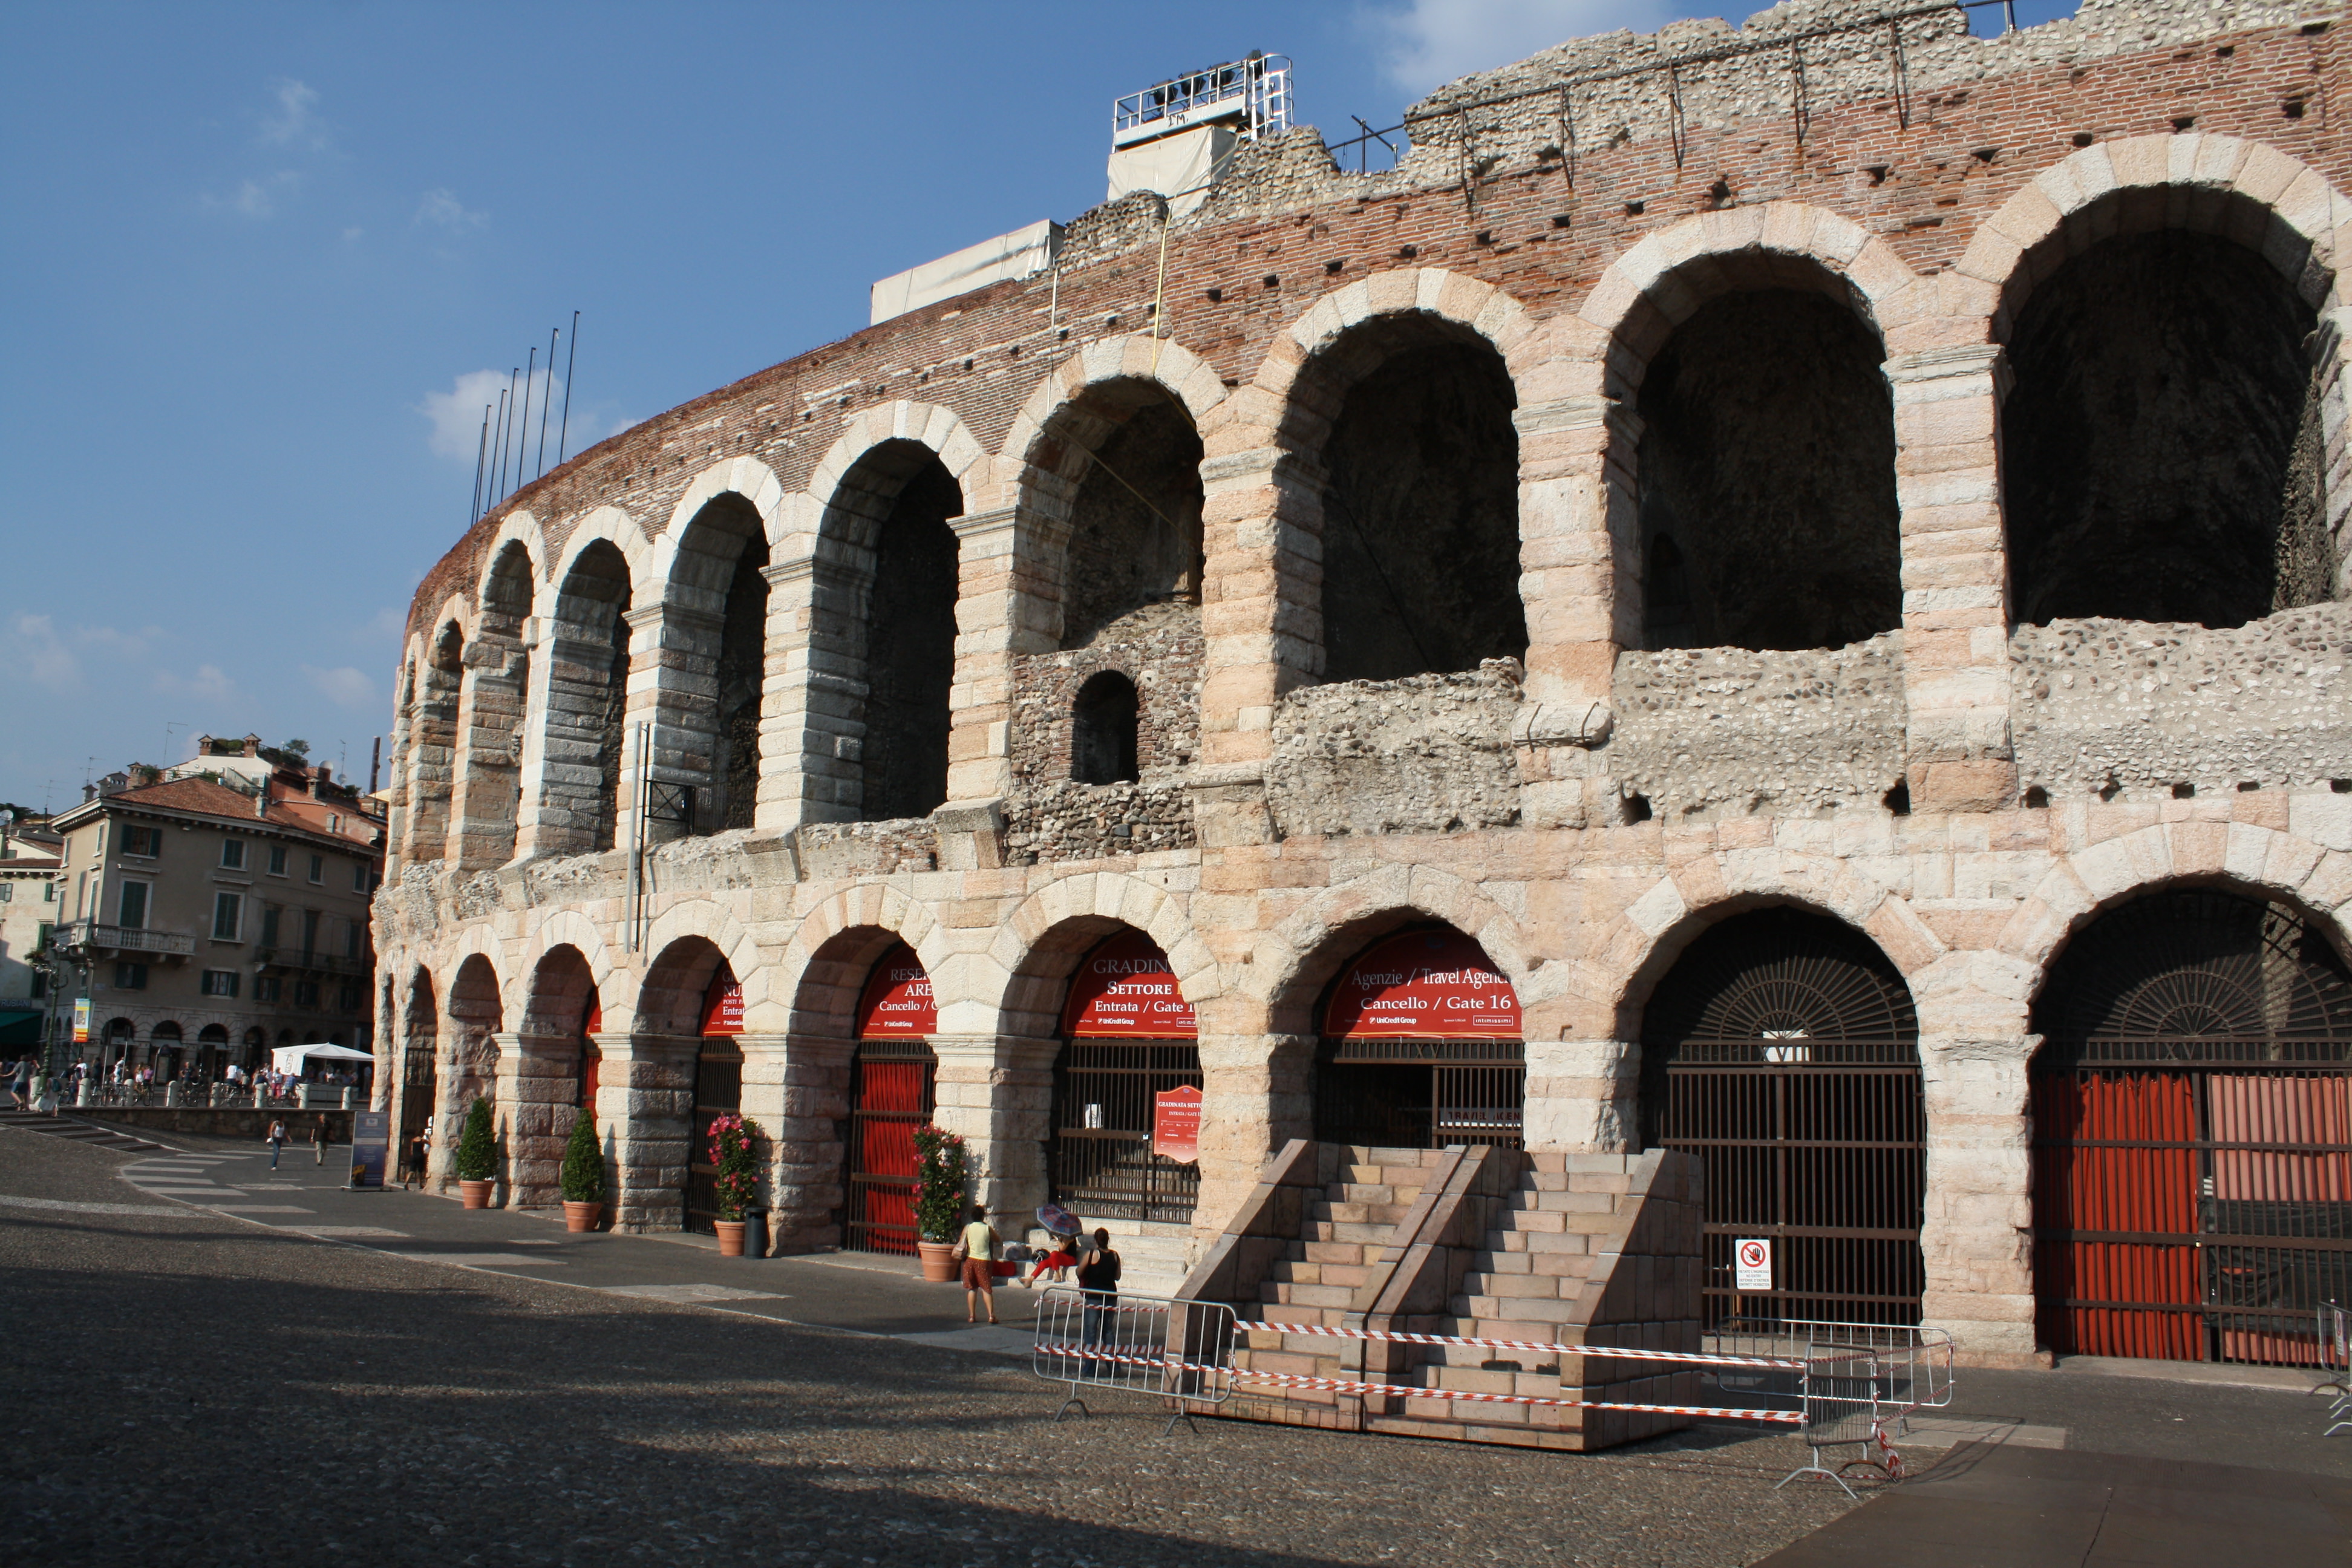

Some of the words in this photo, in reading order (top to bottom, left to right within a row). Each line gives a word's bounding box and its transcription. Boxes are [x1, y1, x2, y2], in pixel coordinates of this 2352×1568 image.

[1093, 959, 1175, 973] GRADIN
[1351, 969, 1403, 991] Agenzie
[1422, 968, 1459, 984] Travel
[1107, 981, 1172, 995] SETTORE
[879, 1001, 920, 1011] Cancello
[1095, 1000, 1138, 1012] Entrata
[1154, 1001, 1183, 1013] Gate
[1361, 997, 1428, 1010] Cancello
[1446, 997, 1485, 1010] Gate
[1489, 995, 1511, 1010] 16
